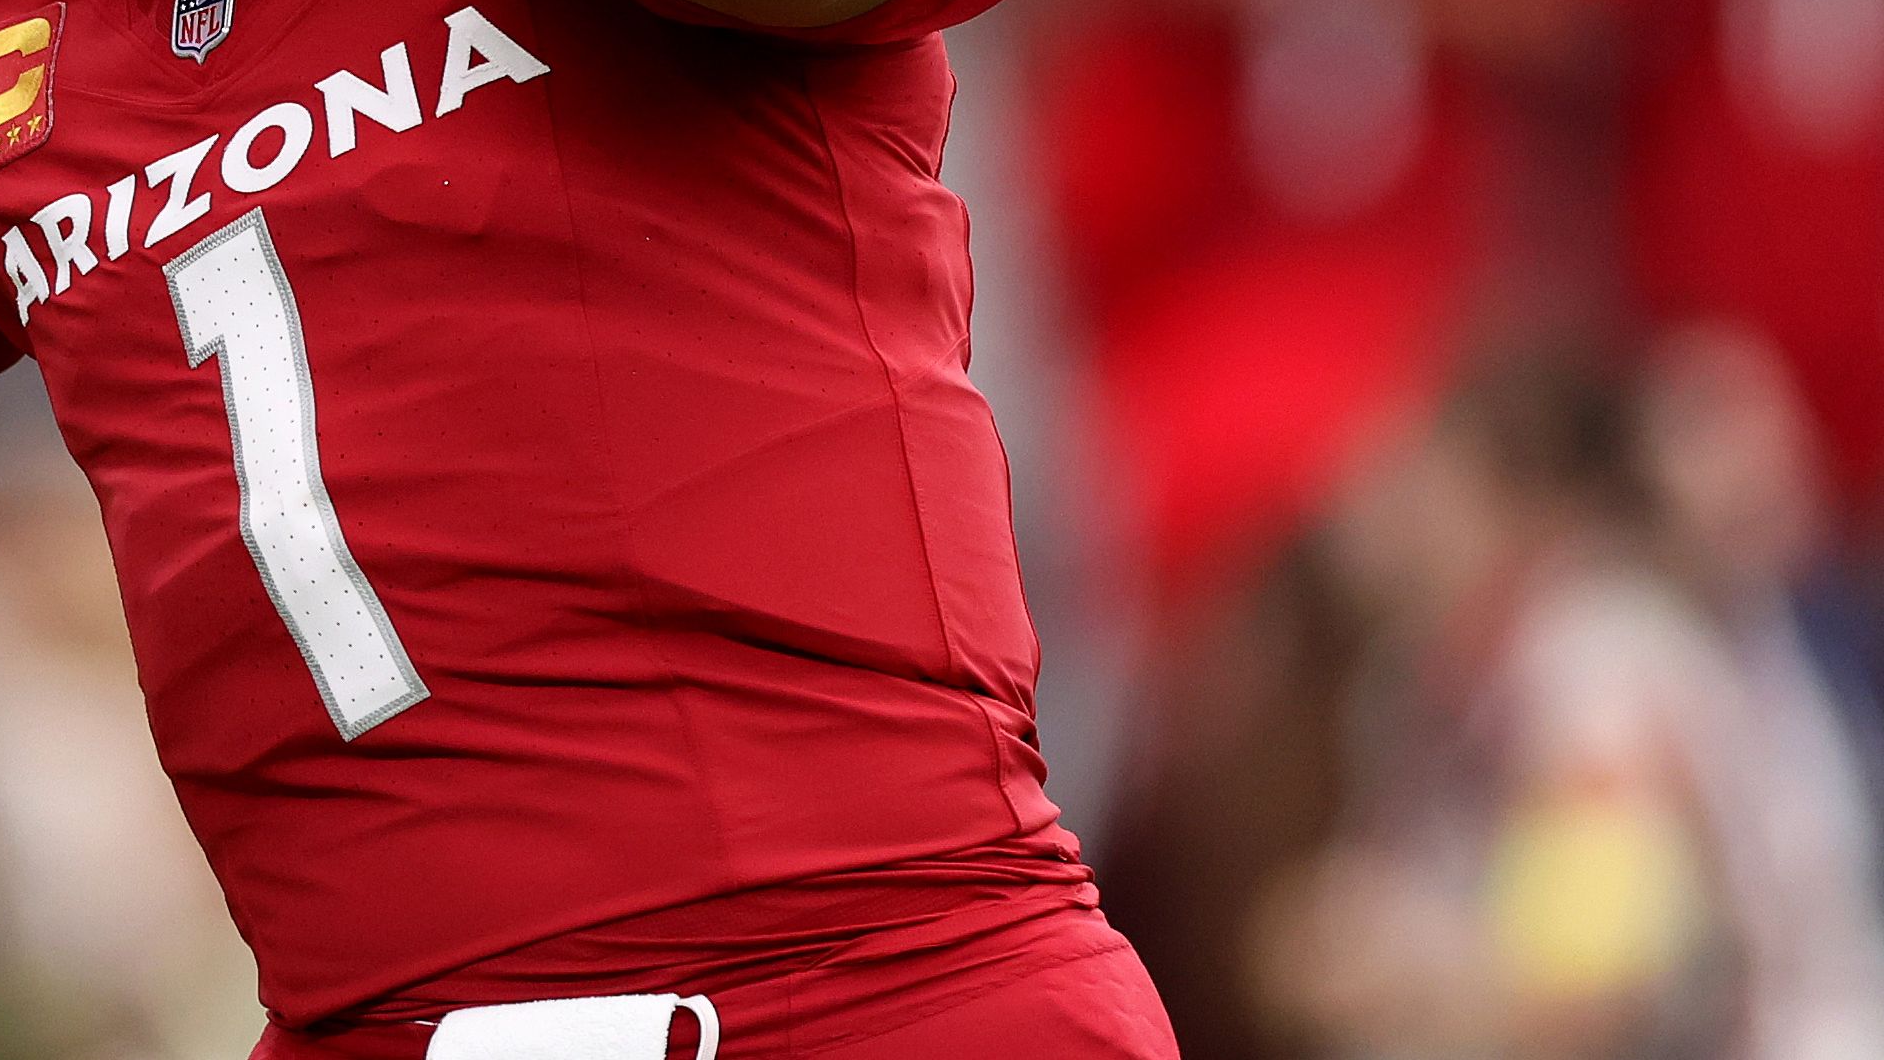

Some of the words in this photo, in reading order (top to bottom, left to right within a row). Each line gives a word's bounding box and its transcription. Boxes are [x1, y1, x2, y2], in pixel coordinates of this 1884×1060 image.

[1, 5, 551, 327] ARIZONA
[179, 5, 220, 44] NFL
[162, 205, 432, 742] 1
